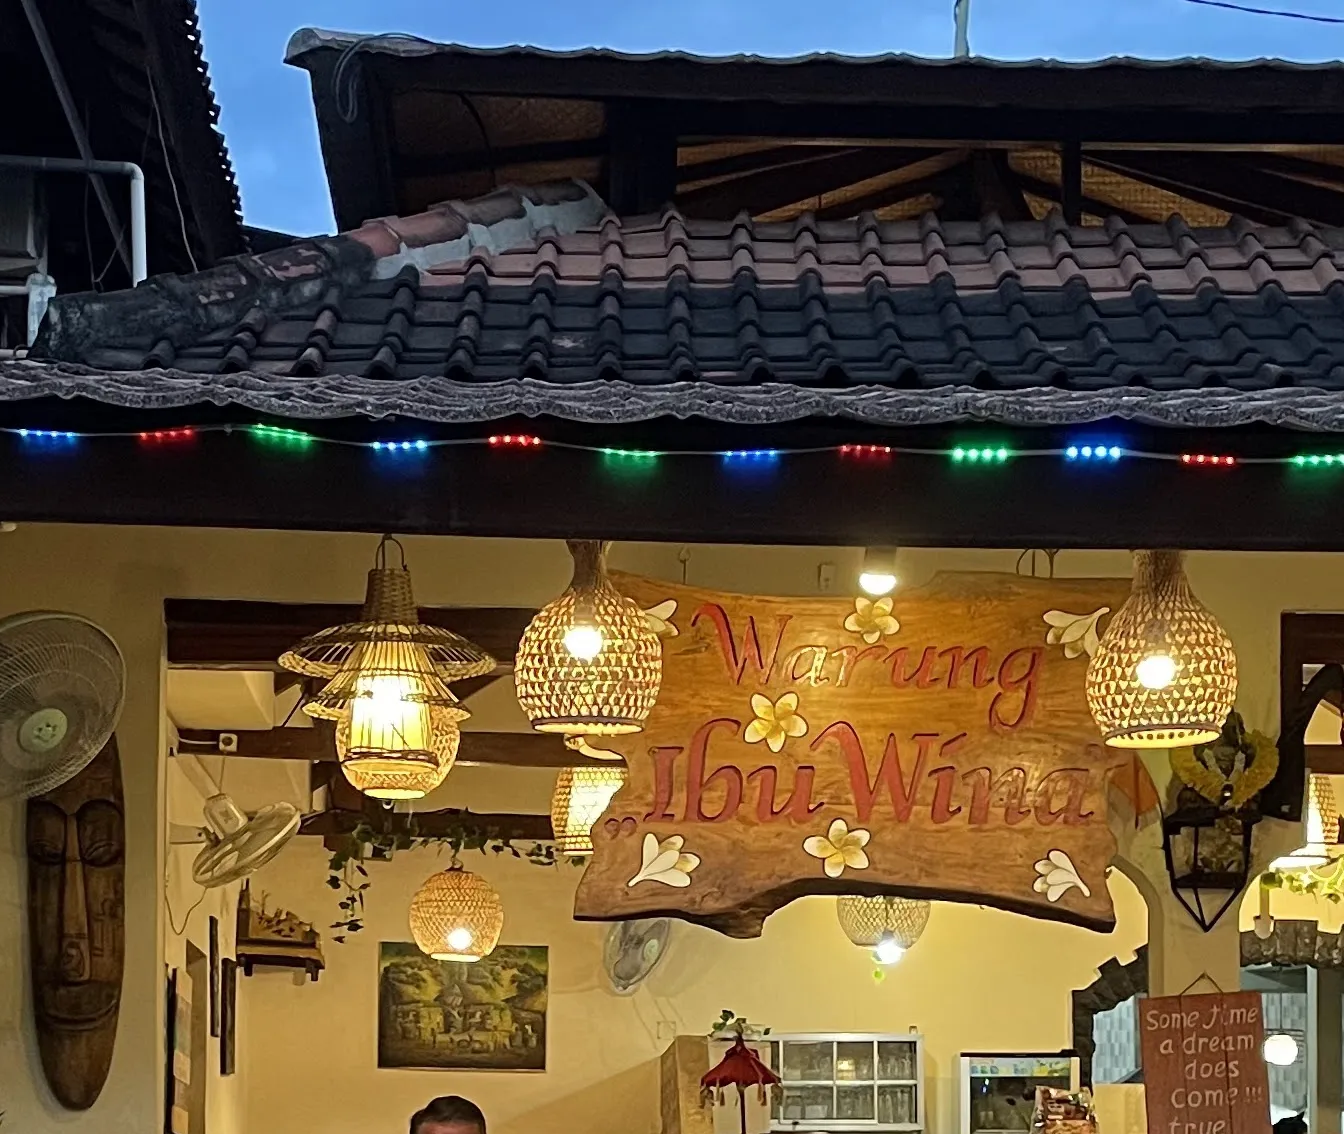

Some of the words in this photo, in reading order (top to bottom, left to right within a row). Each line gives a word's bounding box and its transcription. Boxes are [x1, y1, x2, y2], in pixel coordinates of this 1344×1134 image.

[691, 602, 1044, 733] Warung
[1146, 1009, 1200, 1031] Some
[1159, 1038, 1175, 1055] a
[1182, 1031, 1255, 1055] dream
[1184, 1058, 1240, 1081] does
